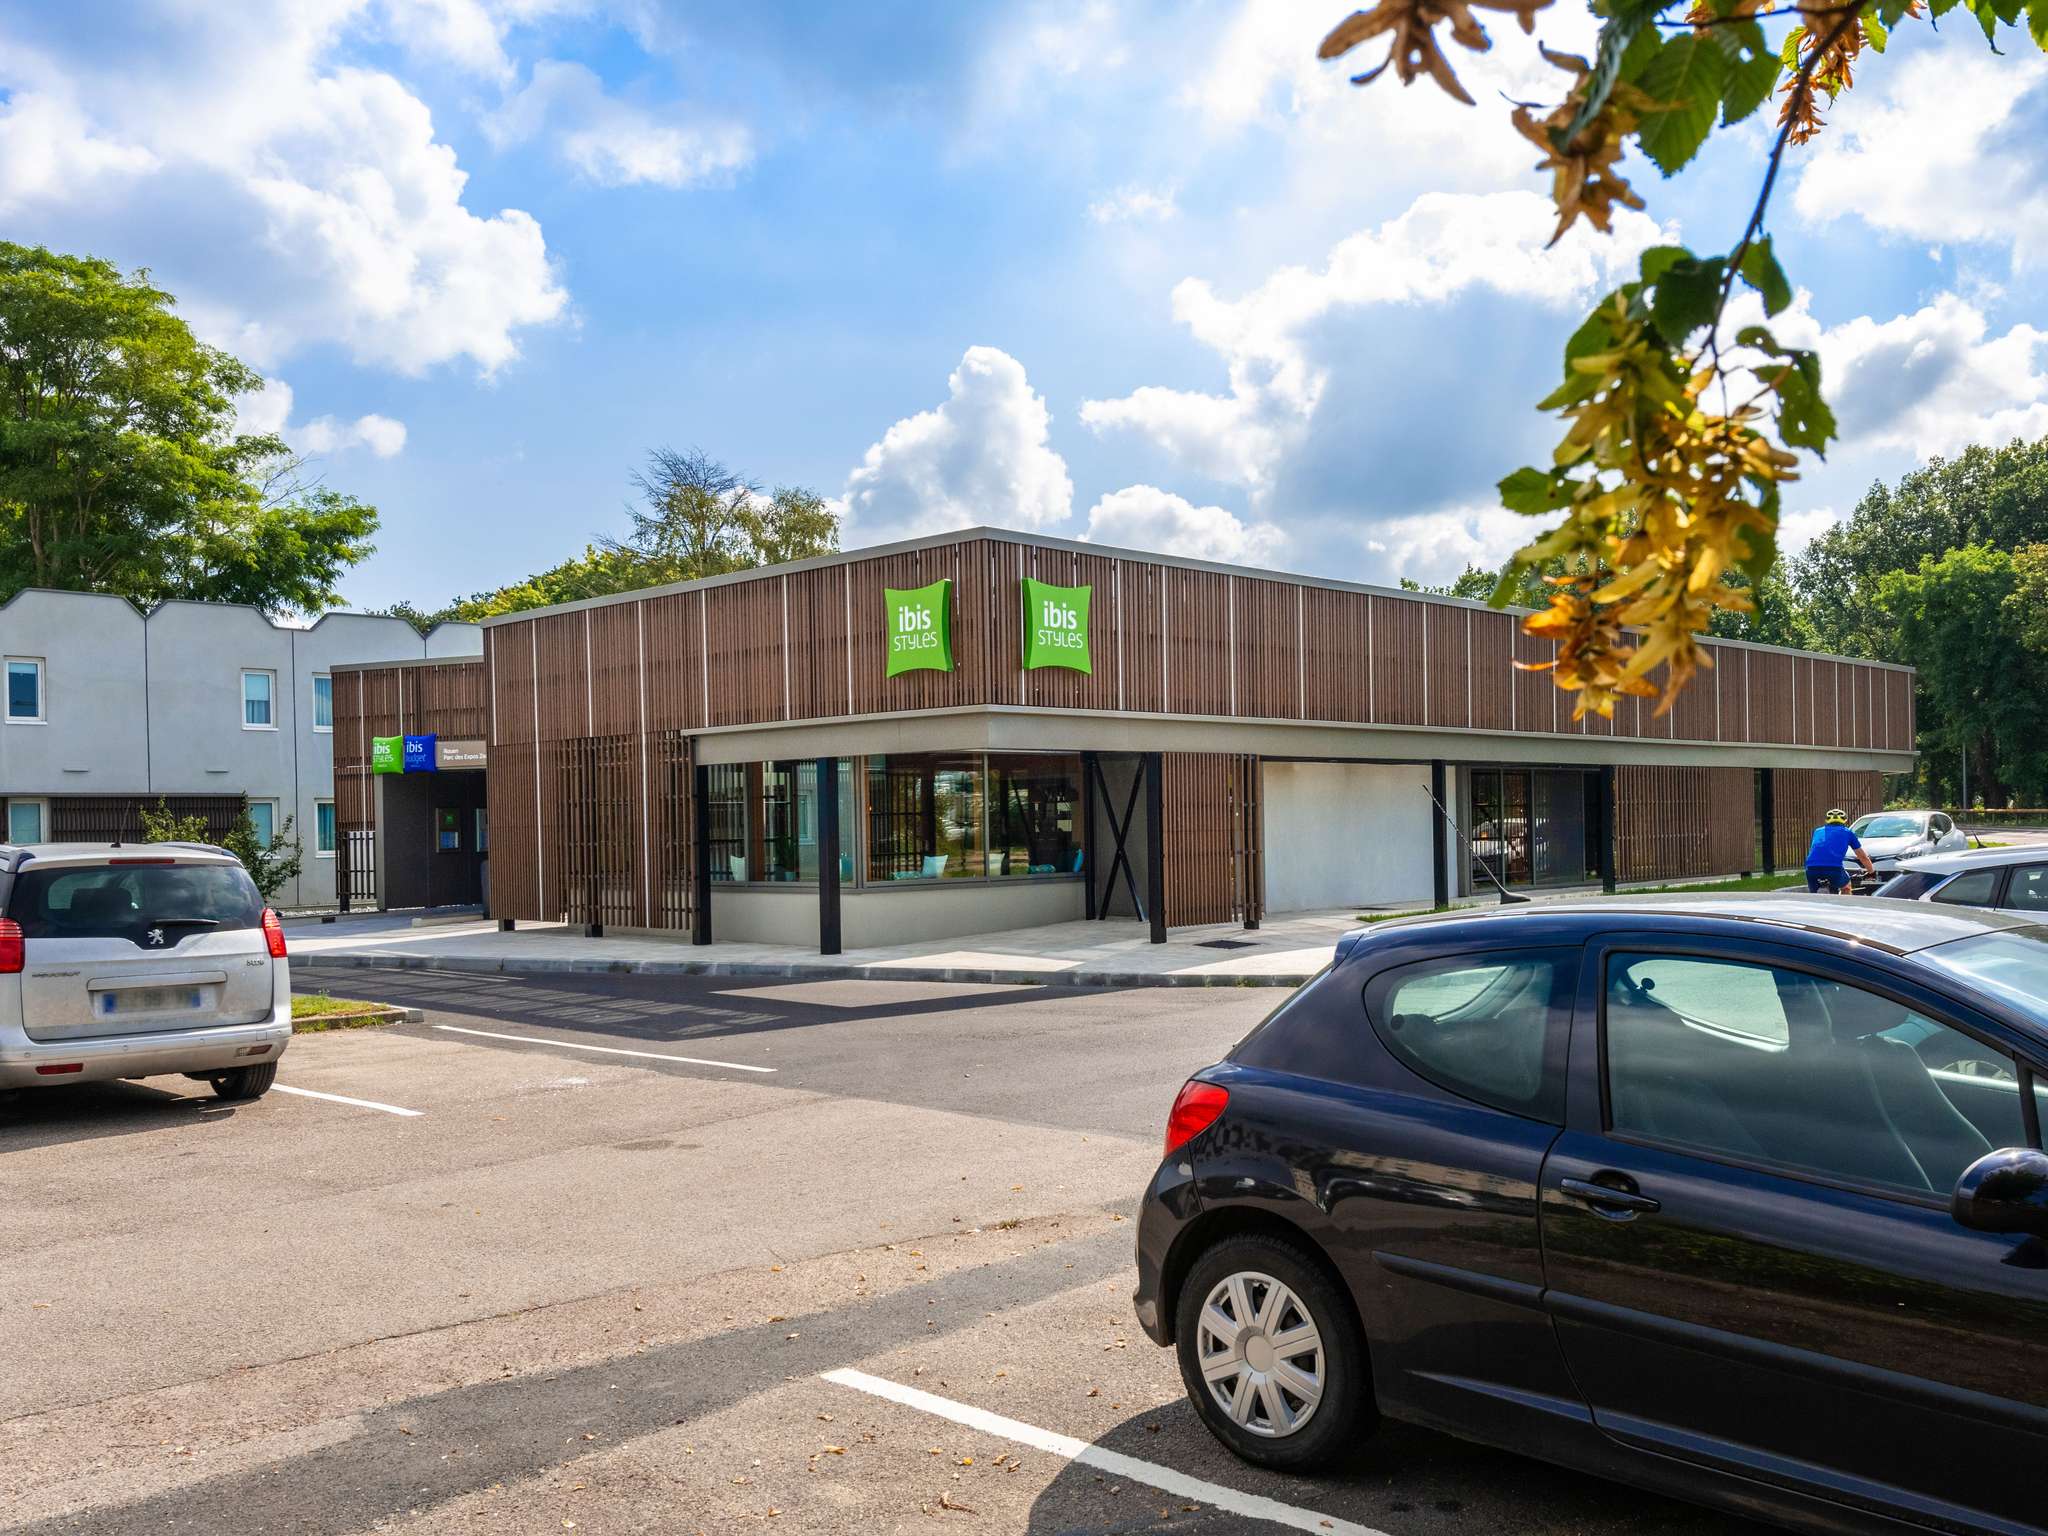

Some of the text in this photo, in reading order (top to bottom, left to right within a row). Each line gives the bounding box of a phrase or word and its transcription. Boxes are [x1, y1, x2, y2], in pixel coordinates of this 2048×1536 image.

[898, 604, 931, 632] ibis
[1043, 601, 1077, 630] ibis
[373, 742, 390, 755] ibis
[407, 741, 423, 753] ibis
